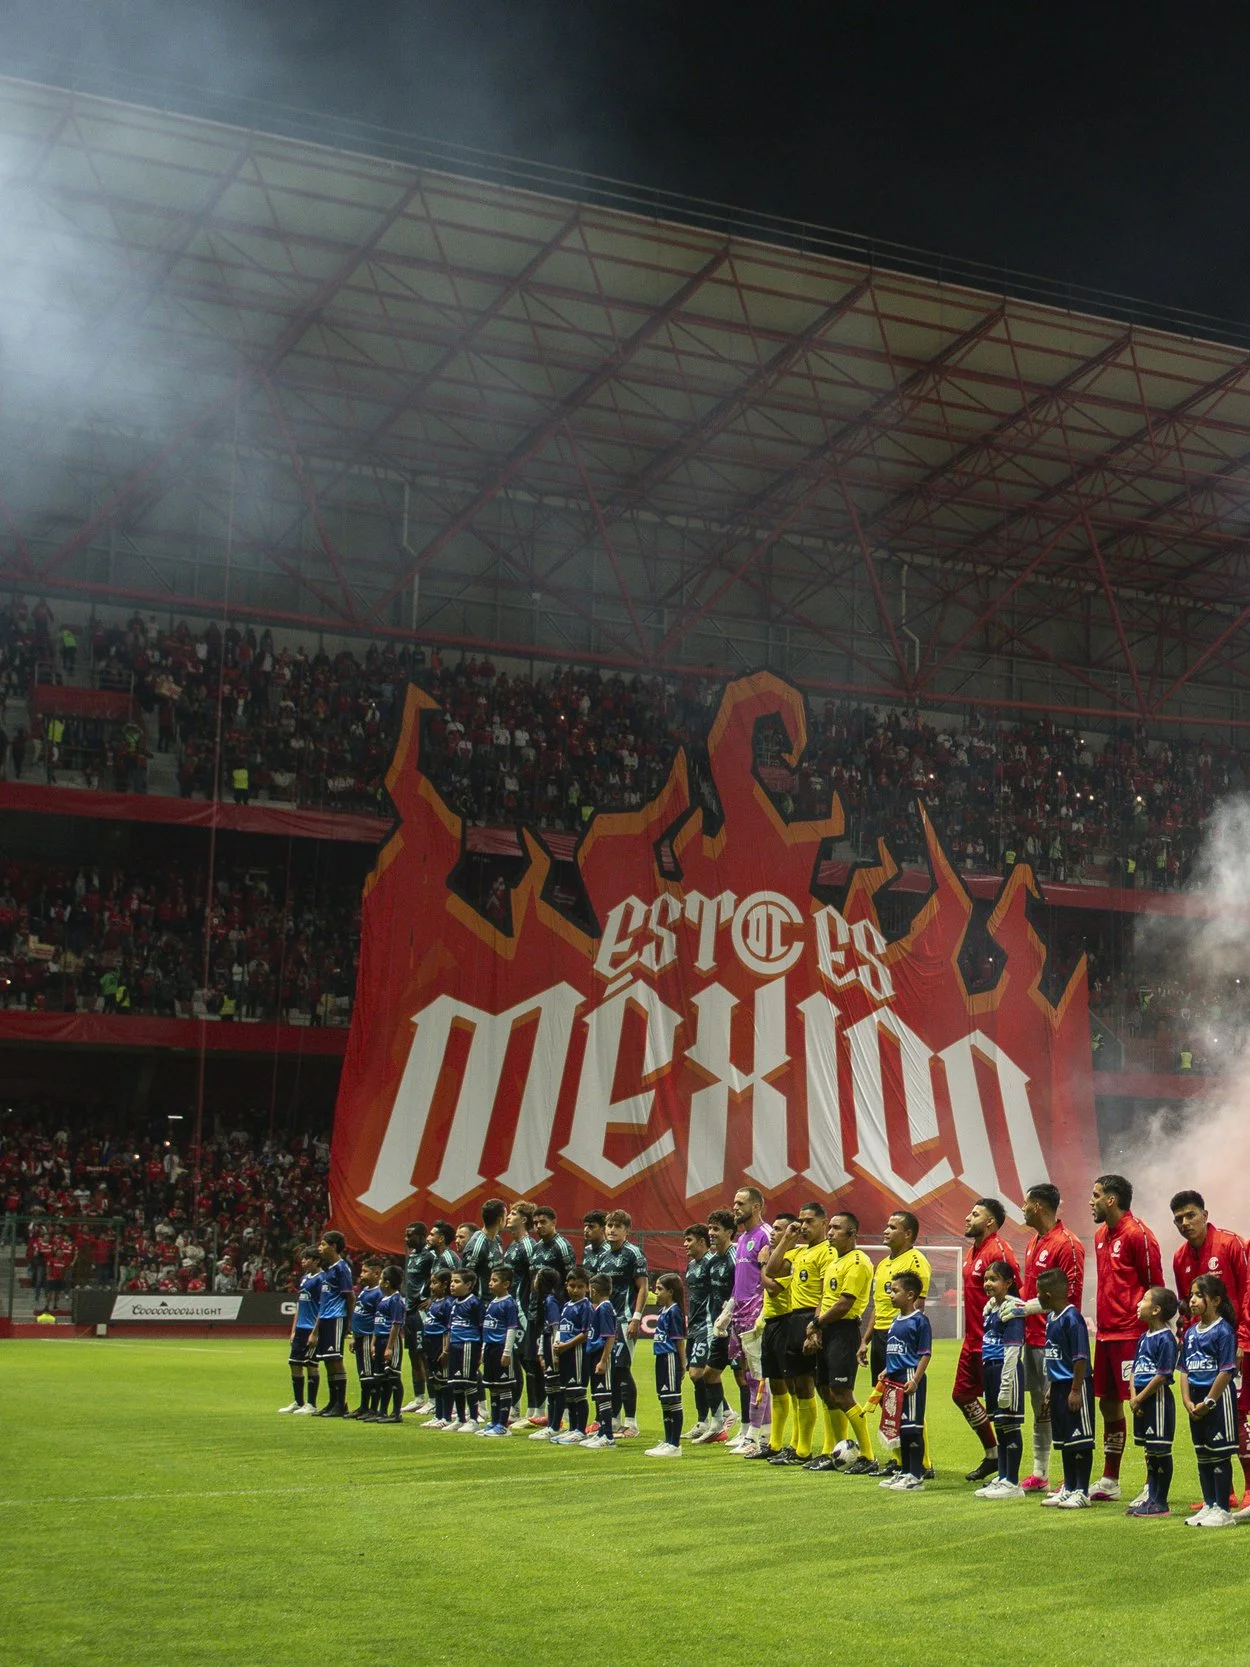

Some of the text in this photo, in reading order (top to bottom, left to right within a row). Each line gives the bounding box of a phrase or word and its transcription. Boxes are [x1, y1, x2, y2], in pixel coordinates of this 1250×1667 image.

[813, 904, 896, 1000] ES
[357, 972, 1050, 1226] MÉXICO
[196, 1307, 222, 1316] LIGHT
